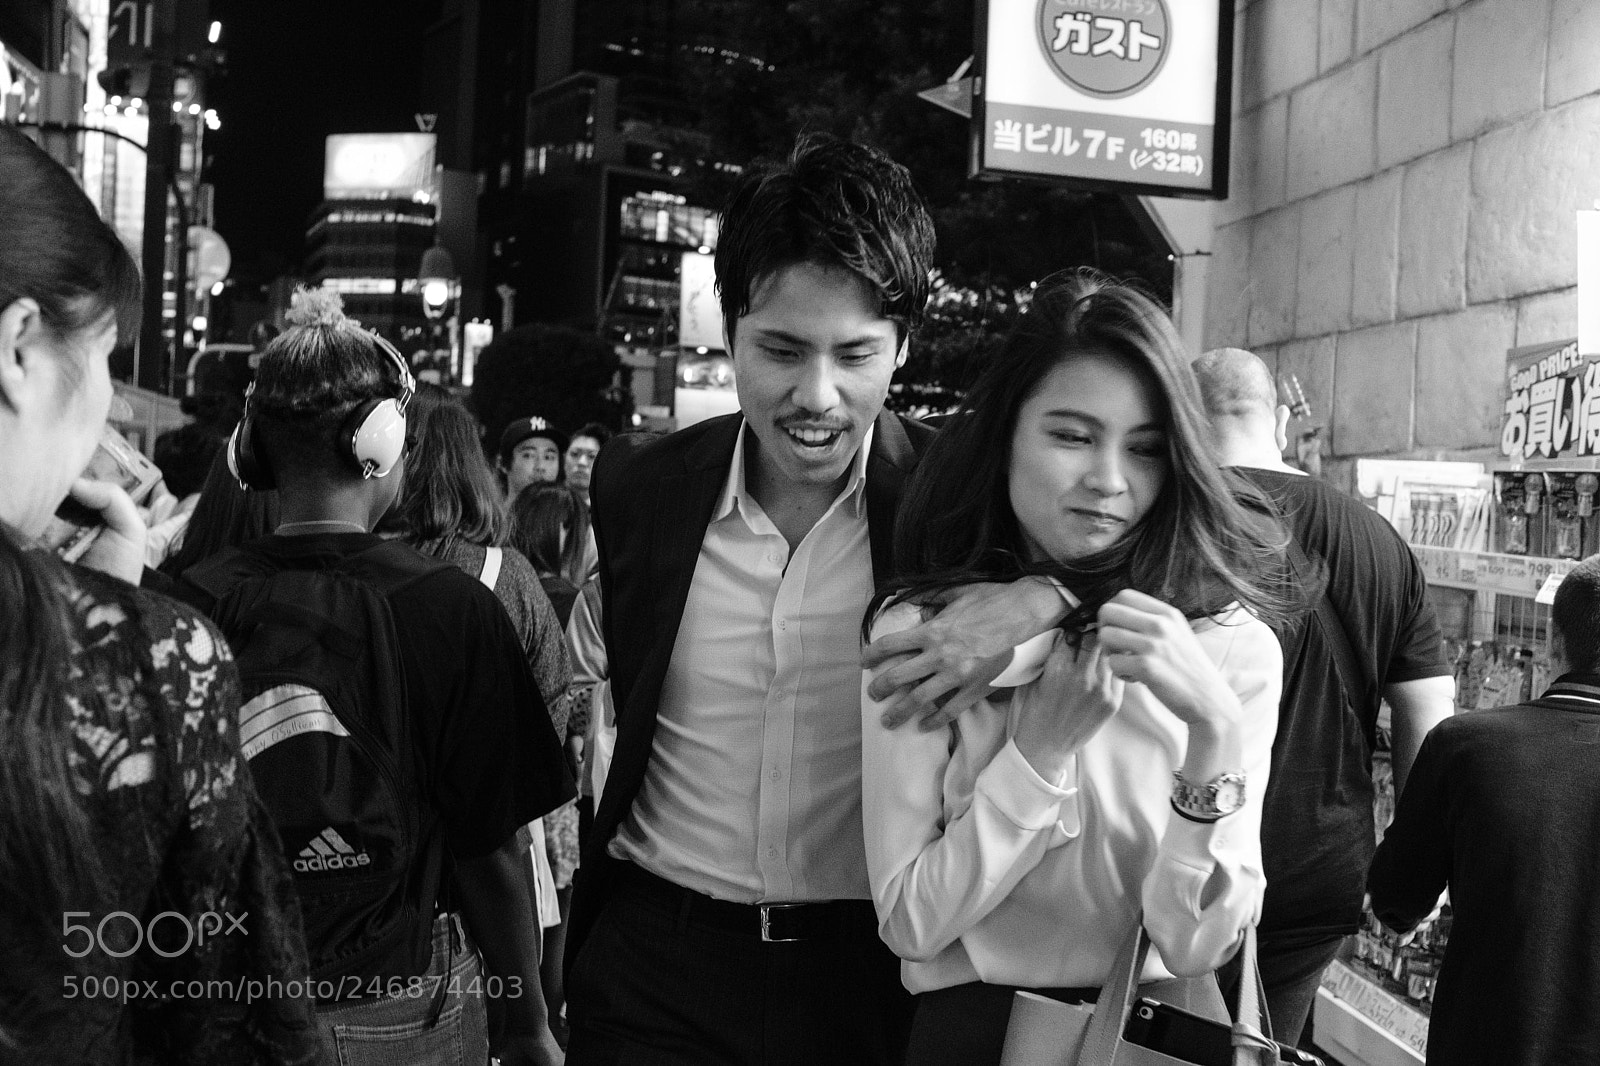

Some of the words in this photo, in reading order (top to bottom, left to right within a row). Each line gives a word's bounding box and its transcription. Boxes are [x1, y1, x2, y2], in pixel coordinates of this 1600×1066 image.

[1052, 11, 1161, 62] ガスト
[1140, 127, 1198, 151] 160席
[293, 853, 371, 873] adidas
